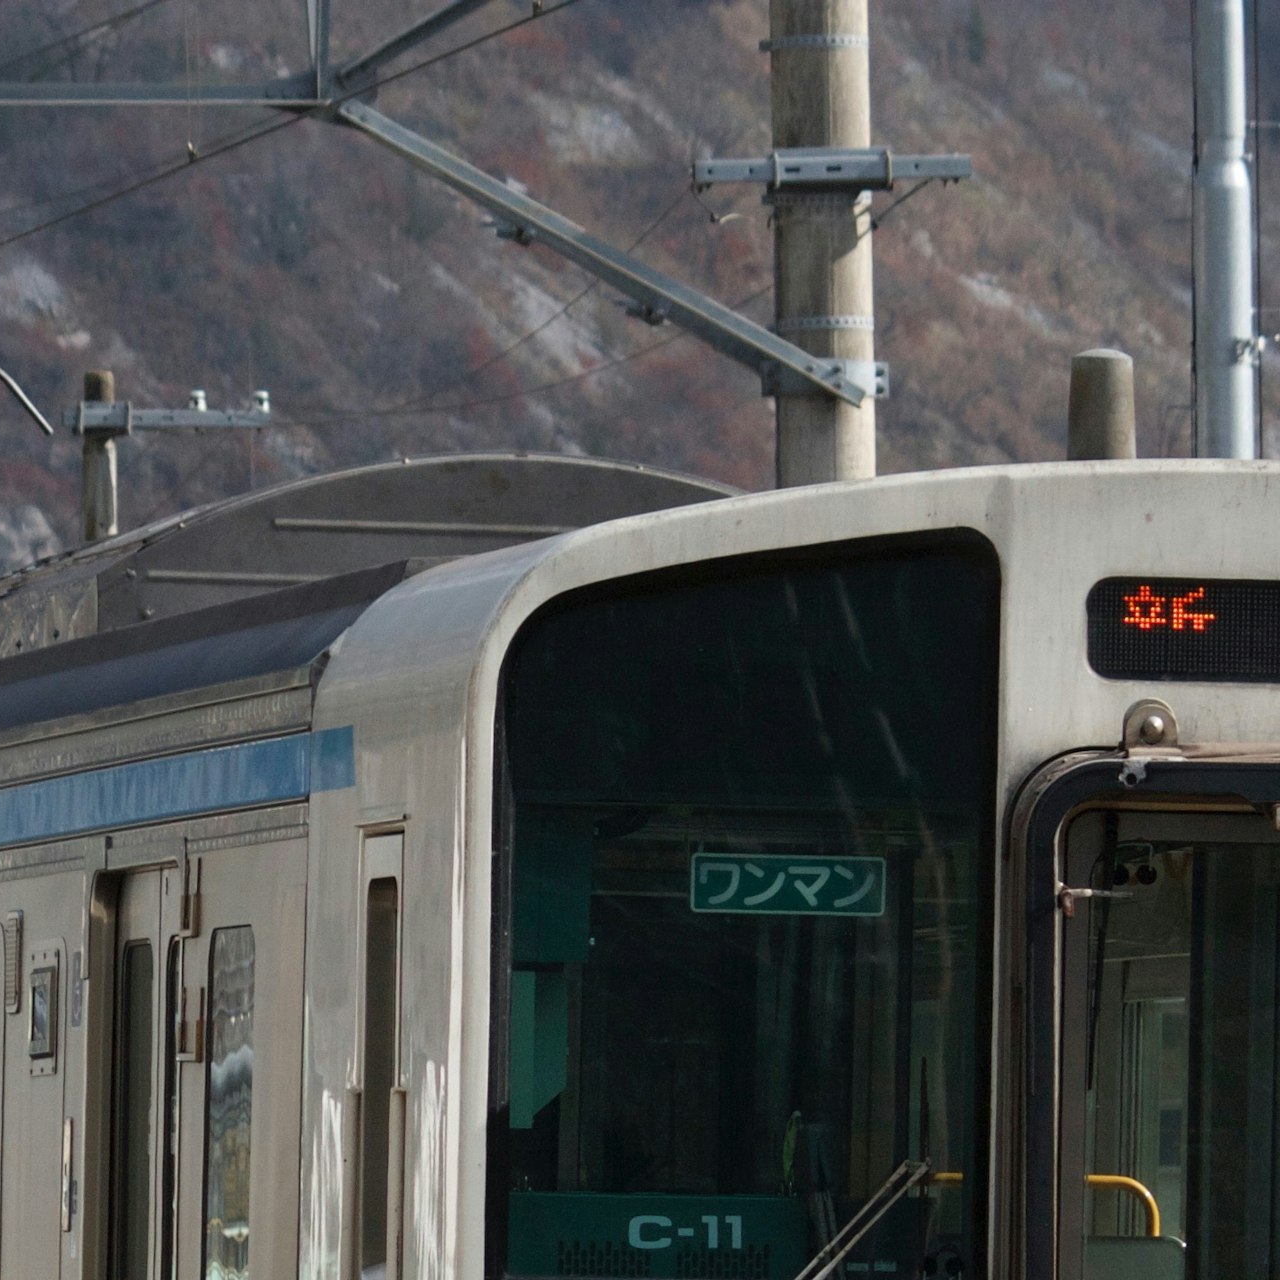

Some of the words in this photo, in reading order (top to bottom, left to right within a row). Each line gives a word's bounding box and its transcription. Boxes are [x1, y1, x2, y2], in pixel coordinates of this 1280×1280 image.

[699, 862, 876, 908] ワンマン
[628, 1215, 742, 1250] C-11
